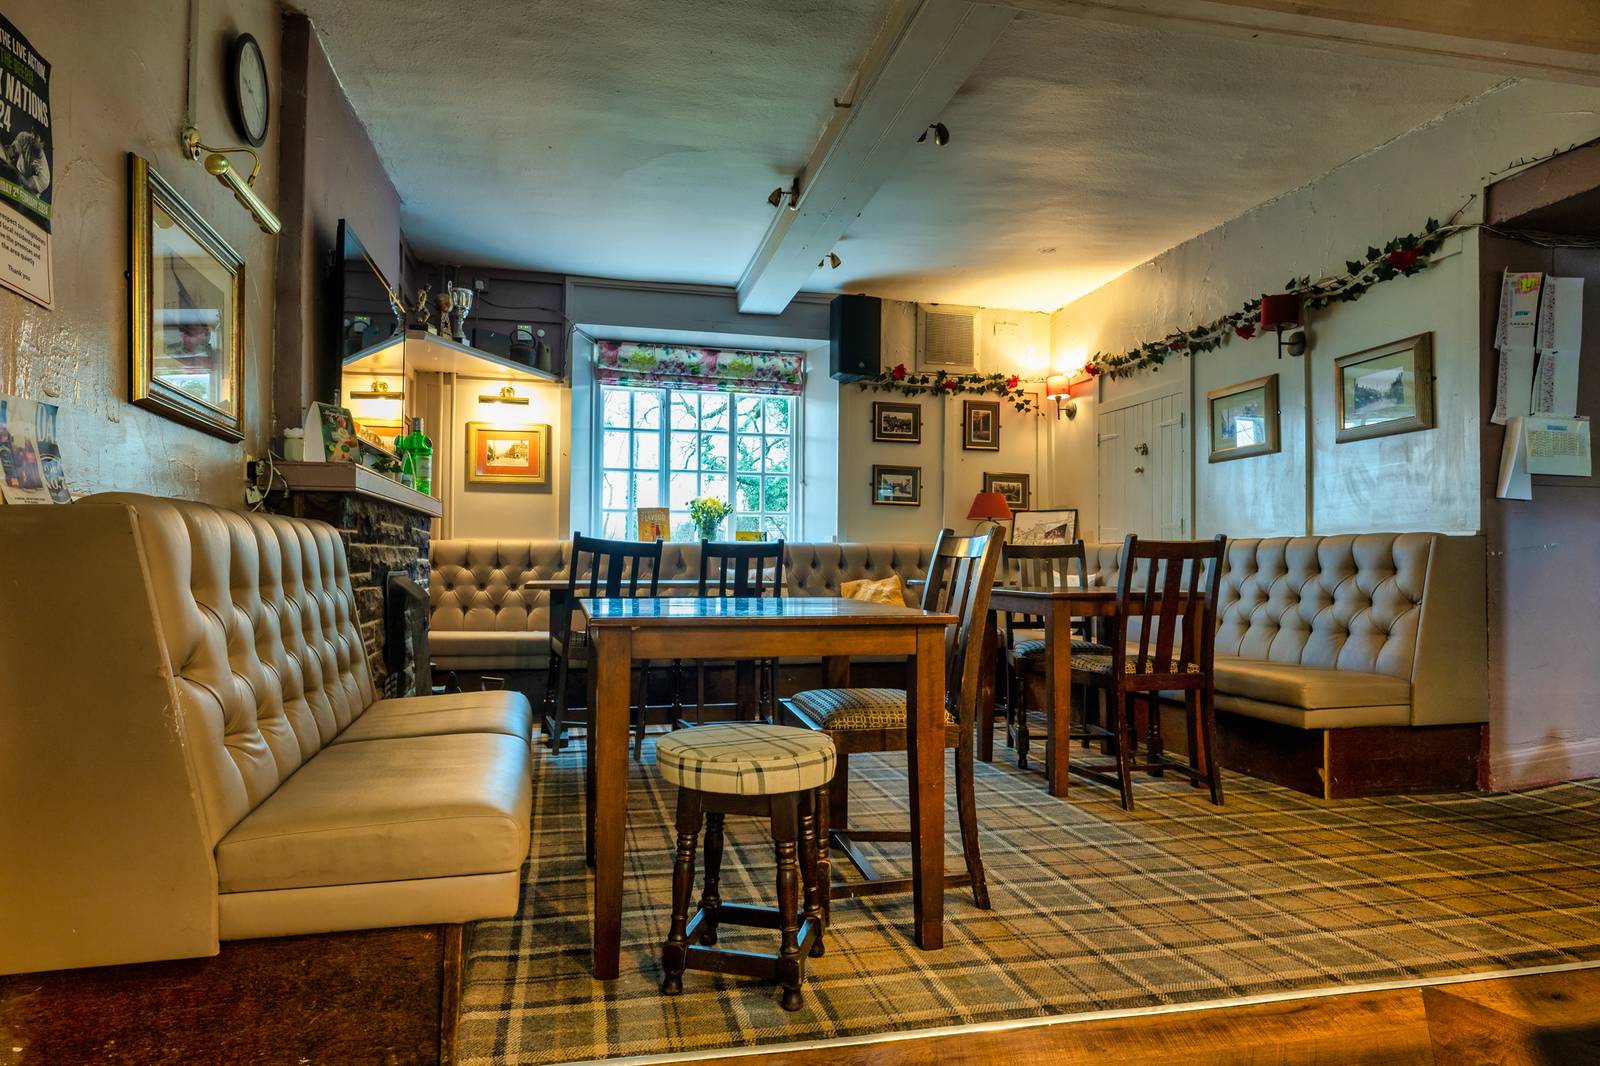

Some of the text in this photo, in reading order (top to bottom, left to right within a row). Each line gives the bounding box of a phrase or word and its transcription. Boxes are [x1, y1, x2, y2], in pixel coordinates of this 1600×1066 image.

[12, 38, 27, 62] LIVE
[5, 72, 49, 128] NATIONS
[1, 241, 9, 251] the
[6, 234, 14, 244] the
[8, 263, 31, 282] Thank you
